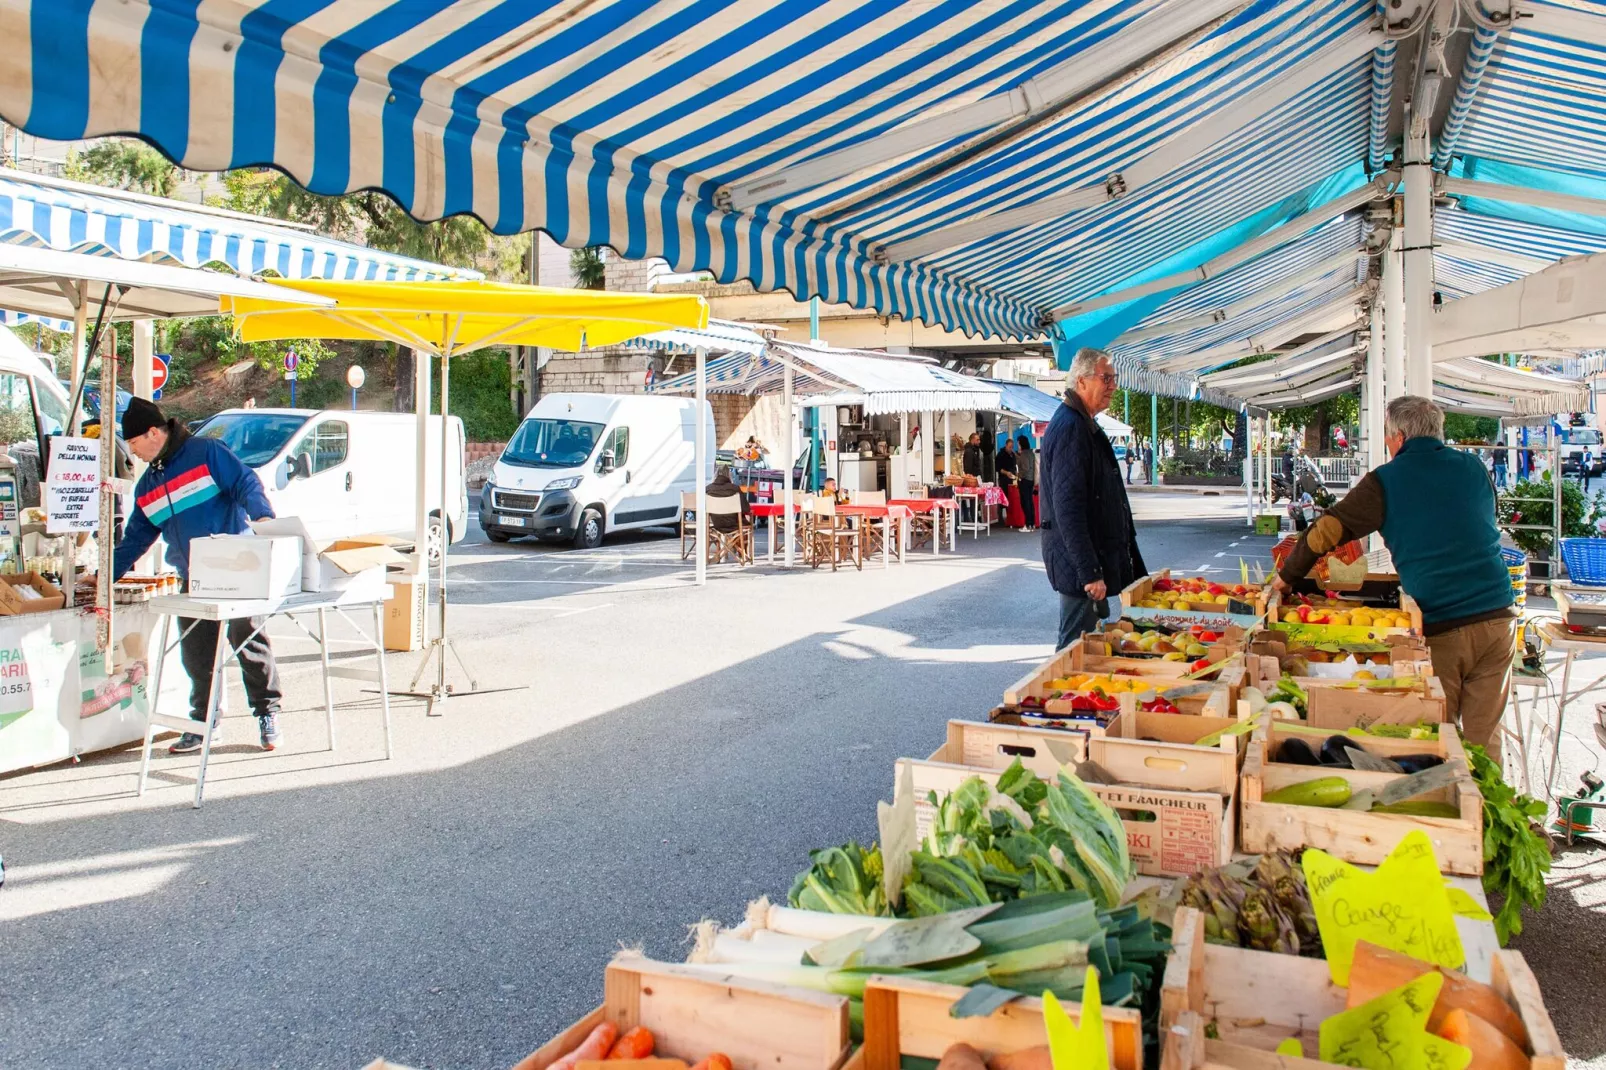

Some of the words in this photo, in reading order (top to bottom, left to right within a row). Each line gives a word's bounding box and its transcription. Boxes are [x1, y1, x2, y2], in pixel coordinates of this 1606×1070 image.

[62, 473, 82, 482] 18,00
[1107, 793, 1124, 801] ET
[1128, 794, 1207, 811] FRAICHEUR
